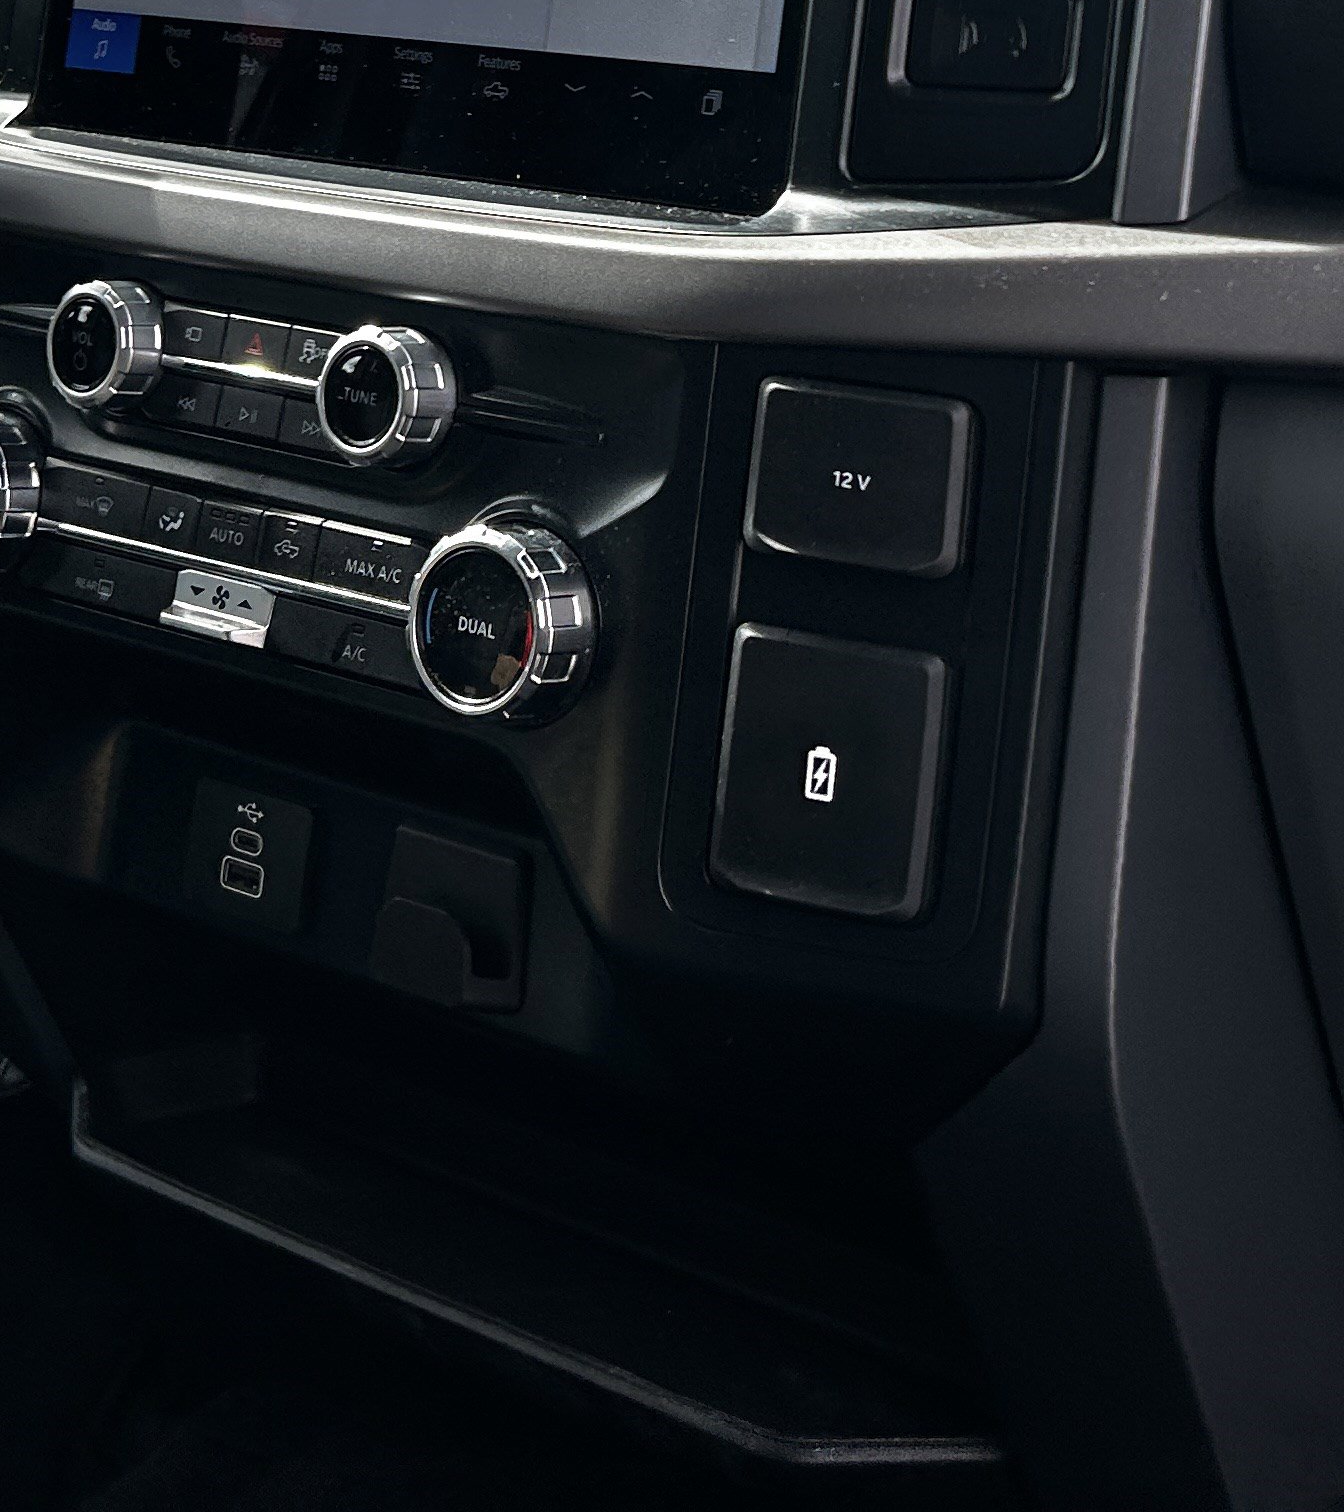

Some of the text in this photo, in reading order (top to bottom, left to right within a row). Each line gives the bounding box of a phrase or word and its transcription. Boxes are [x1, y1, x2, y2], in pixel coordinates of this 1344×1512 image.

[91, 18, 117, 32] Audio
[163, 24, 192, 39] Phone
[222, 30, 284, 49] Audio Sources
[320, 40, 344, 55] Apps
[394, 46, 434, 64] Settings
[478, 54, 522, 72] Features
[344, 386, 378, 407] TUNE
[833, 470, 871, 491] 12 V
[209, 528, 244, 545] AUTO
[344, 558, 403, 584] MAX A/C
[457, 615, 496, 640] DUAL
[341, 644, 368, 663] A/C
